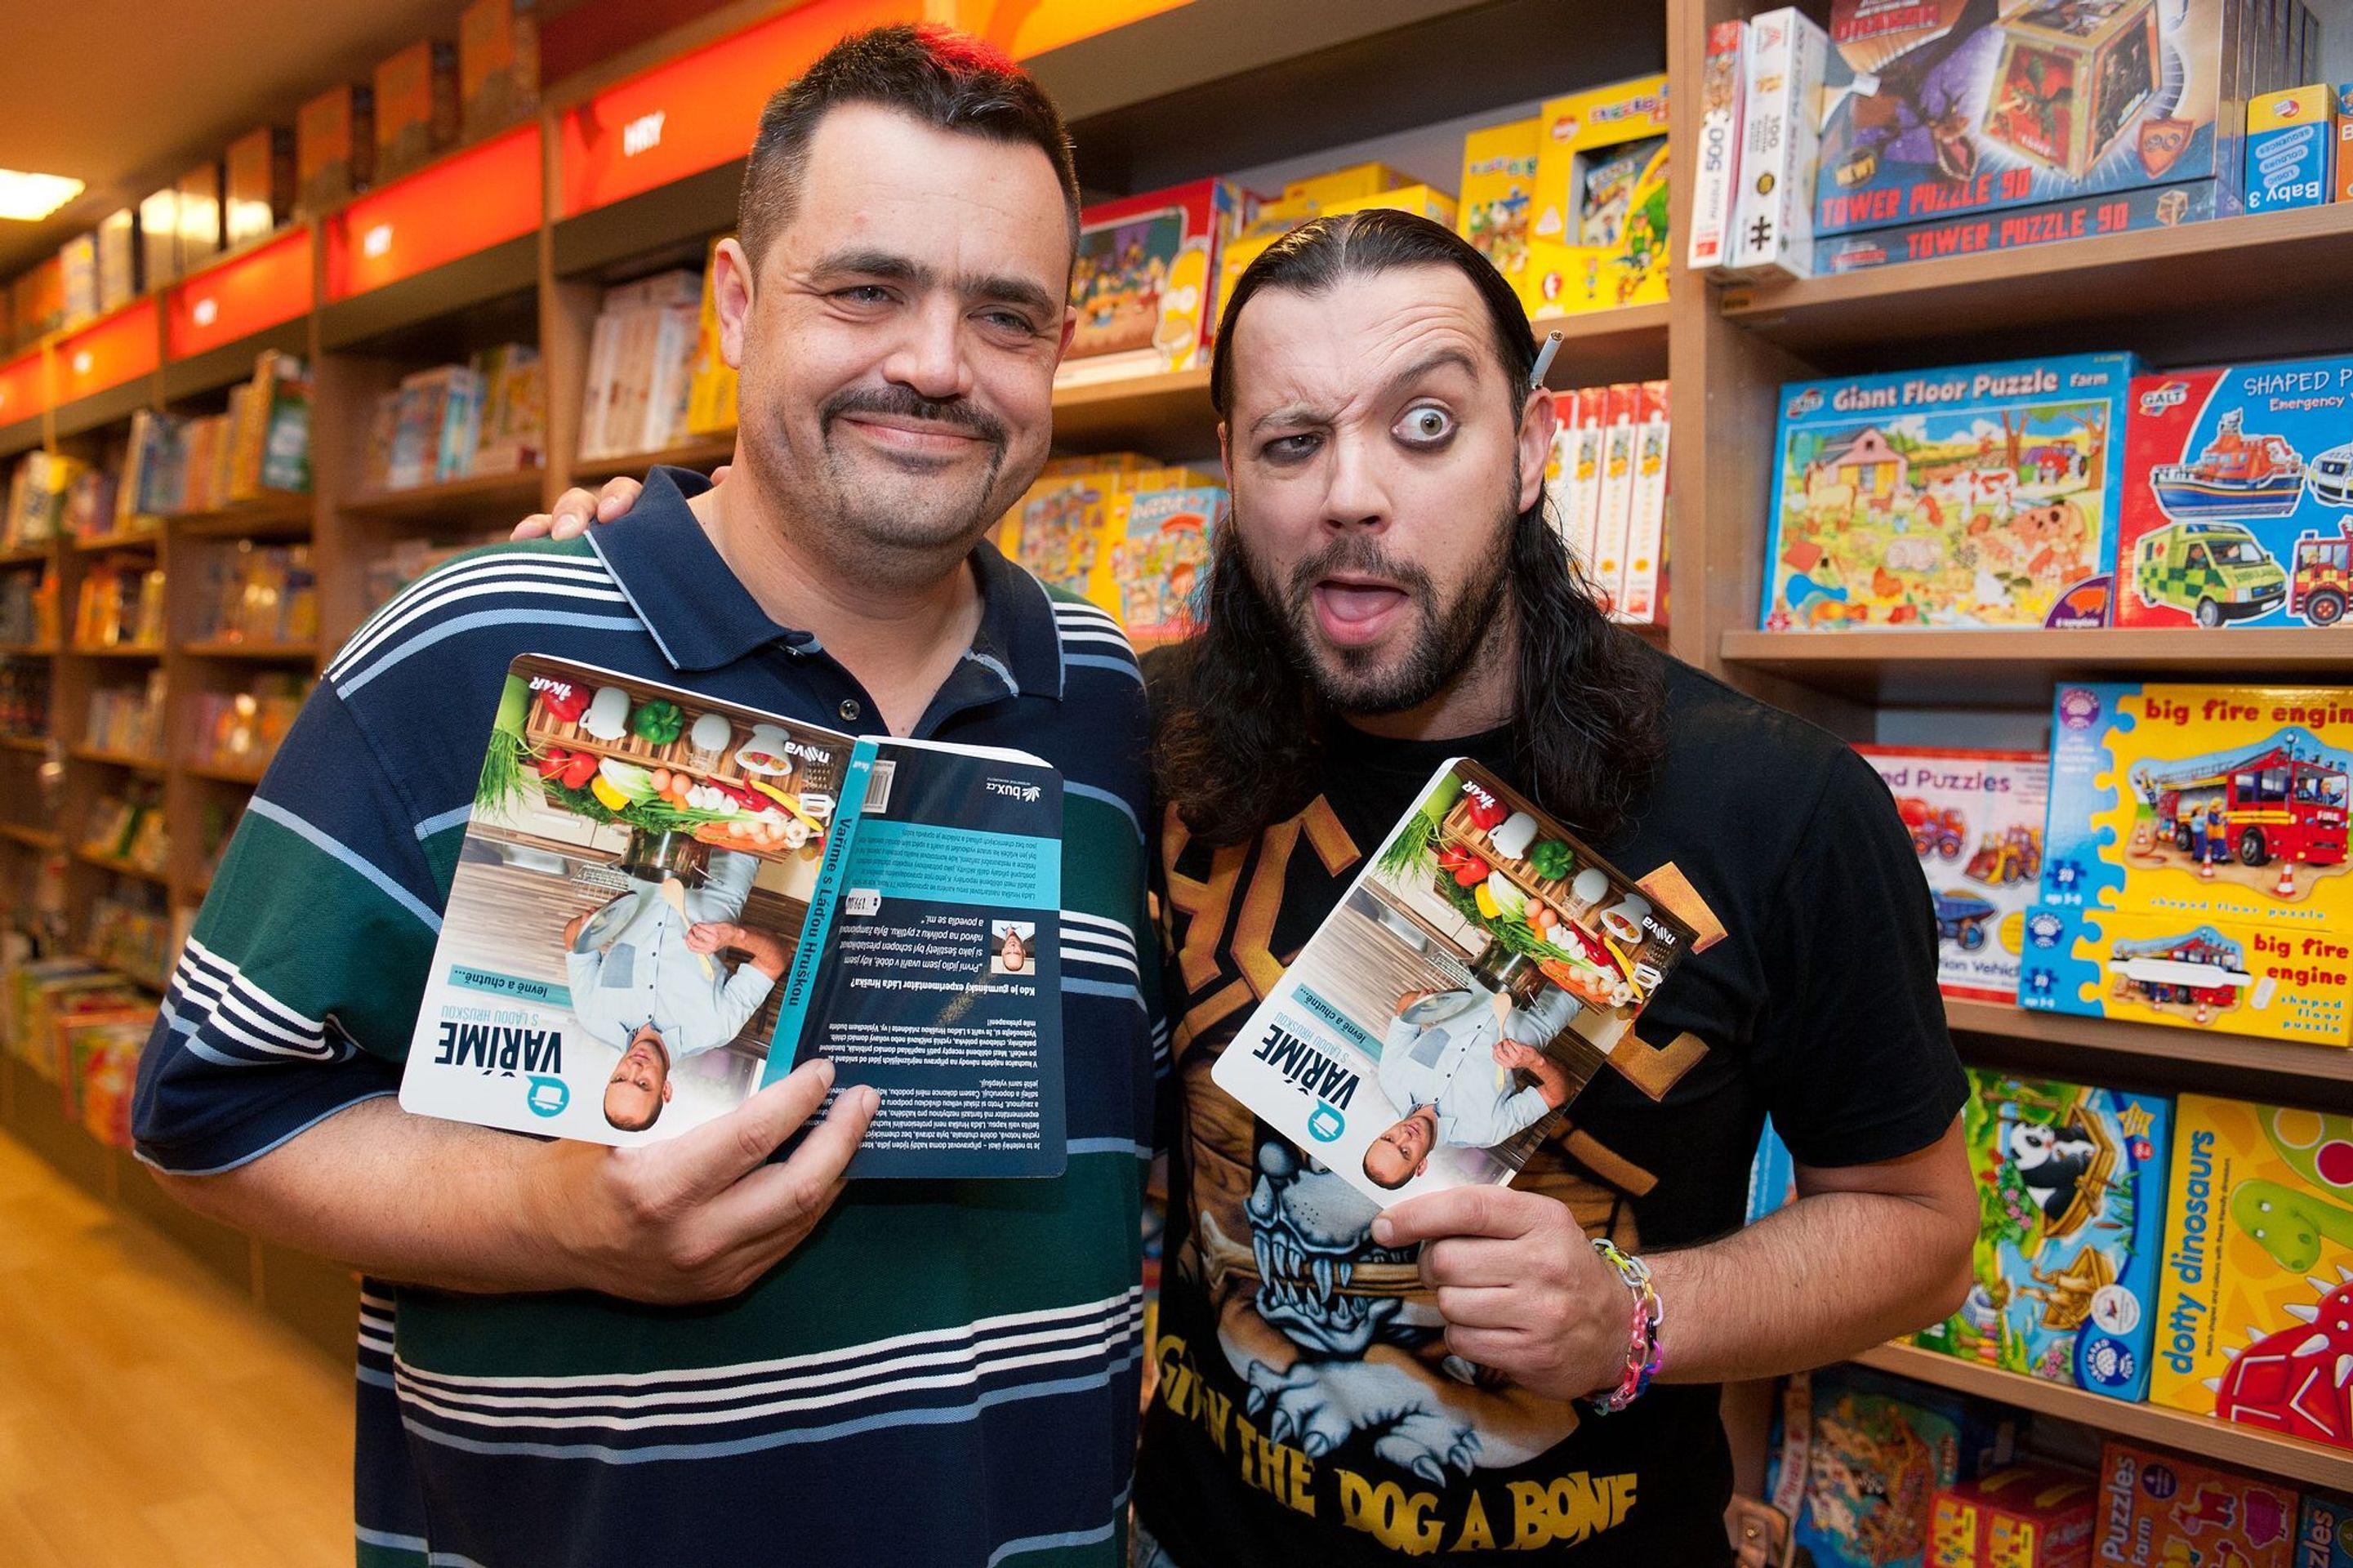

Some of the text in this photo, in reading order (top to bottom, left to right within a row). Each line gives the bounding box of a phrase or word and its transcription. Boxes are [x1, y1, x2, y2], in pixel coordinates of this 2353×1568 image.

[2259, 130, 2309, 155] SEQUENCES
[2263, 150, 2303, 170] COLOURS
[1822, 167, 2032, 229] TOWER PUZZLE 90
[2248, 180, 2320, 209] Baby 3
[1907, 220, 1991, 260] TOWER
[1999, 208, 2086, 247] PUZZLE
[2096, 203, 2129, 234] 90
[1833, 369, 2109, 412] Giant Floor Puzzle Farm
[2244, 371, 2329, 397] SHAPED
[2142, 391, 2181, 405] GALT
[2269, 396, 2345, 412] Emergency
[2146, 698, 2189, 725] big
[2203, 698, 2259, 721] fire
[1917, 769, 2011, 792] Puzzles
[985, 782, 1021, 800] bux.cz
[787, 818, 853, 1006] Vaříme s Láďou Hruškou
[2151, 898, 2325, 920] shaped floor puzzle
[874, 925, 889, 938] Byla
[947, 915, 978, 929] povedla
[921, 929, 948, 941] polívku
[960, 933, 983, 942] návod
[882, 942, 913, 954] schopen
[913, 943, 925, 955] byl
[925, 944, 957, 956] šestiletý
[959, 946, 976, 958] jako
[2254, 933, 2349, 959] big fire
[859, 956, 873, 967] kdy
[874, 956, 894, 968] době,
[899, 960, 921, 969] uvařil
[922, 958, 943, 970] jsem
[942, 960, 959, 971] jídlo
[454, 970, 547, 998] levně a chutně...
[2266, 966, 2347, 987] engine
[850, 978, 1036, 996] Kdo je gurmánský experimentátor Láďa Hruška?
[2281, 995, 2342, 1009] shaped
[1336, 1016, 1344, 1025] a
[2297, 1008, 2342, 1021] floor
[1342, 1022, 1366, 1045] levně
[2282, 1020, 2340, 1033] puzzle
[435, 1022, 562, 1077] VAŘÍME
[1252, 1023, 1360, 1111] VAŘÍME
[887, 1098, 913, 1107] podporu
[2161, 1129, 2215, 1374] dotty dinosaurs
[2212, 1262, 2221, 1288] colours
[2210, 1290, 2218, 1304] and
[2208, 1306, 2217, 1331] shapes
[1235, 1418, 1316, 1518] THE
[1334, 1468, 1446, 1557] DOG
[1450, 1488, 1495, 1552] A
[2101, 1456, 2136, 1562] Puzzles
[2131, 1517, 2153, 1566] Farm
